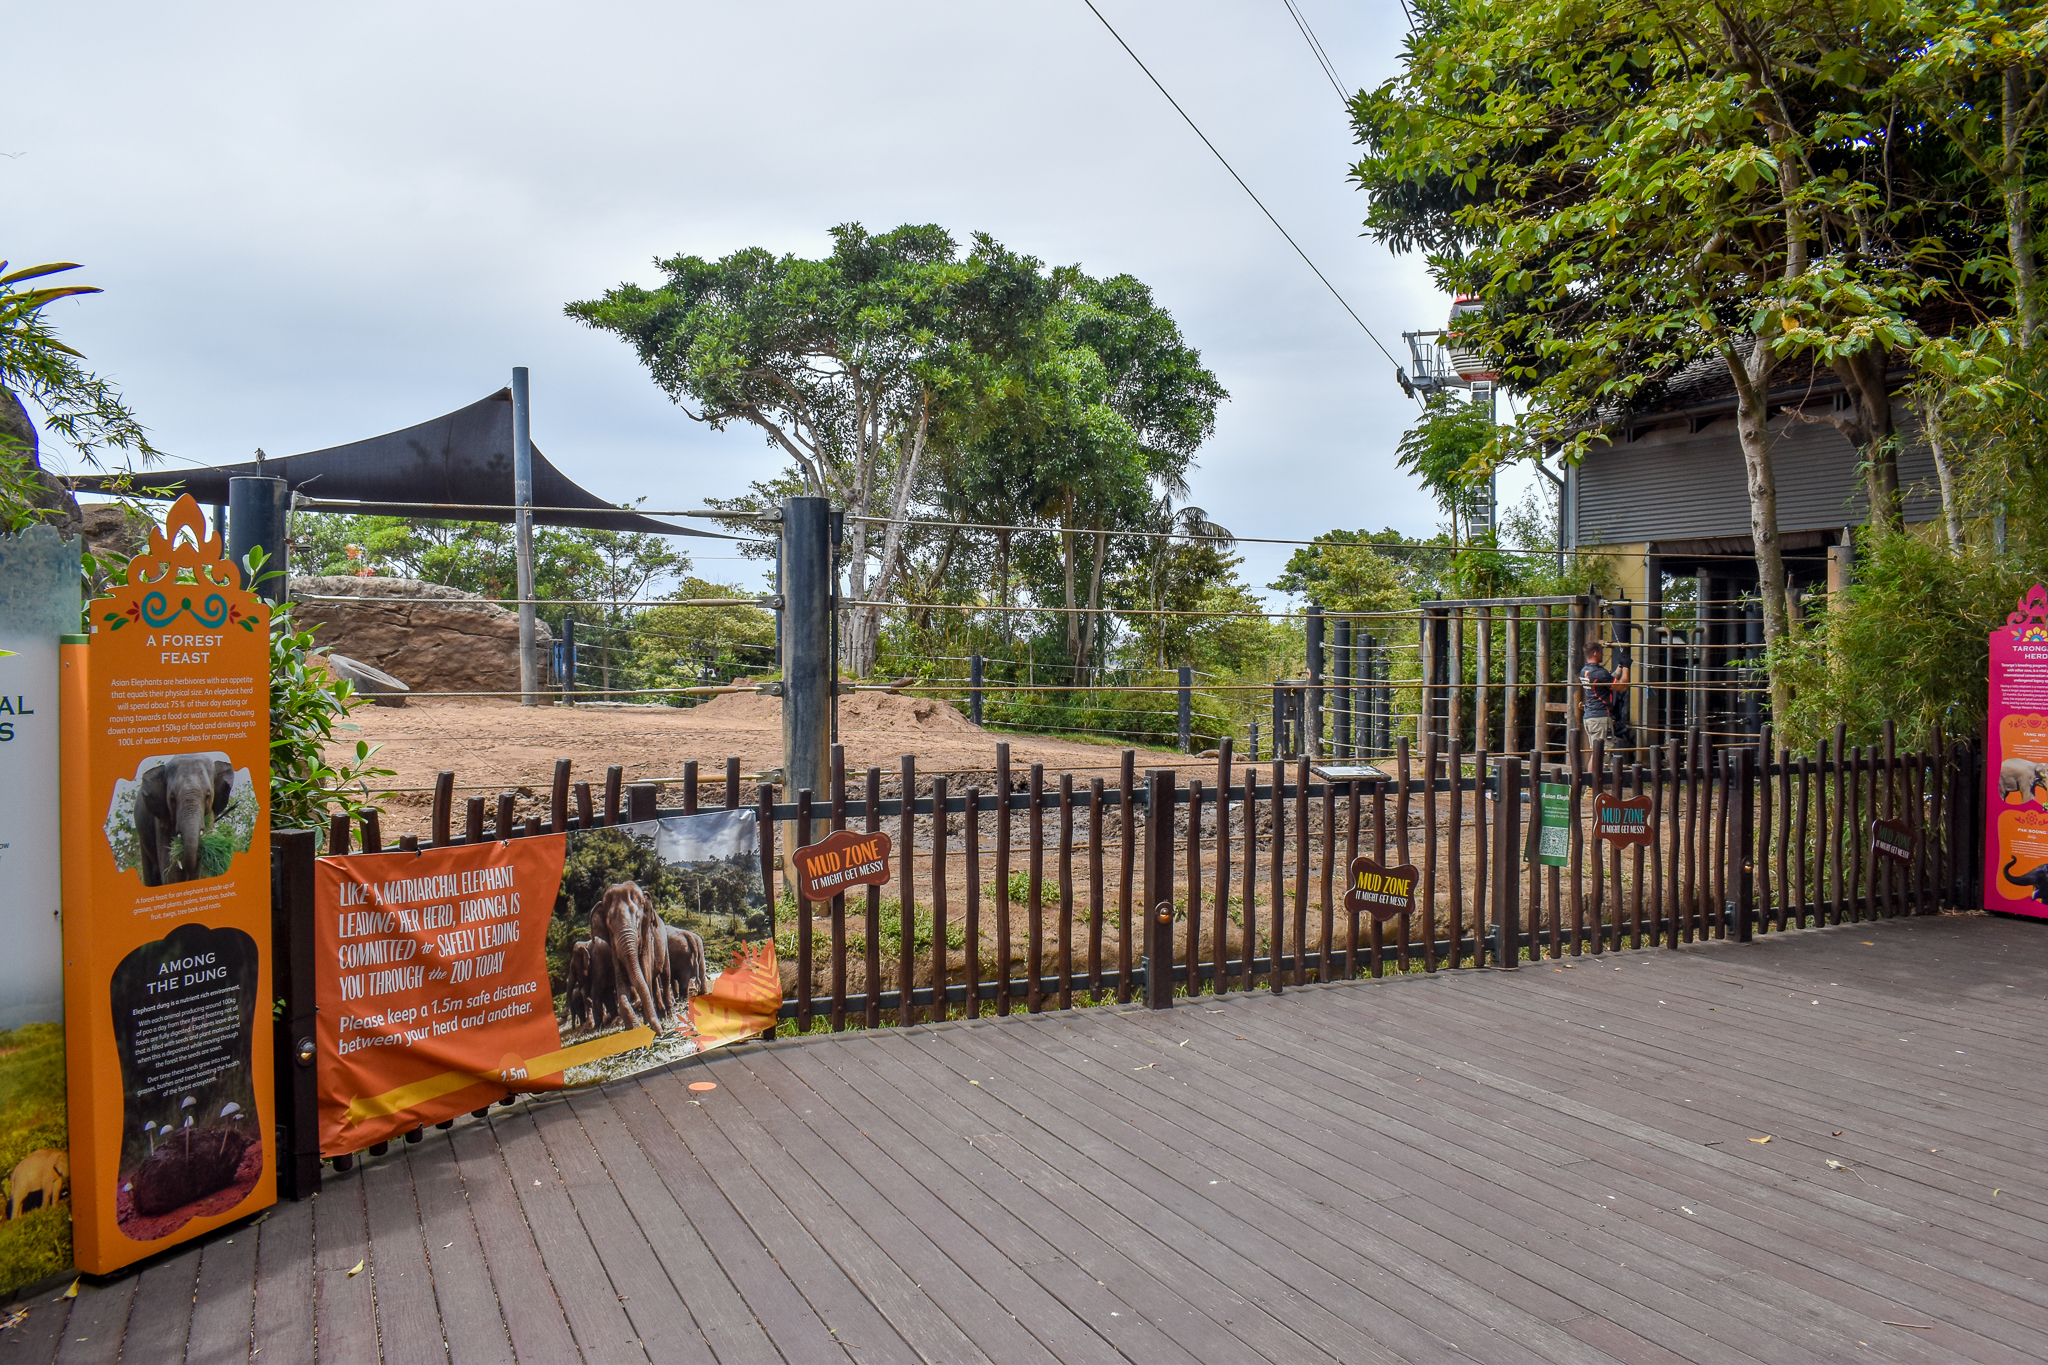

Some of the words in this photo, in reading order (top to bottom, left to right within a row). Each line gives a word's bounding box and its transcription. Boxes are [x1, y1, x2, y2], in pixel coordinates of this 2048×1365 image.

[146, 635, 157, 646] A
[162, 635, 223, 646] FOREST
[161, 652, 210, 663] FEAST
[131, 678, 162, 687] Elephants
[229, 676, 253, 685] appetite
[127, 690, 148, 699] equals
[165, 689, 189, 698] physical
[214, 687, 239, 696] elephant
[109, 715, 134, 723] moving
[136, 713, 160, 721] towards
[230, 709, 255, 718] Chowing
[117, 702, 128, 710] will
[130, 702, 149, 711] spend
[210, 699, 221, 708] day
[222, 699, 240, 707] eating
[108, 727, 126, 735] down
[137, 725, 160, 733] around
[162, 724, 180, 733] 150kg
[189, 722, 203, 730] food
[217, 721, 240, 729] drinking
[118, 738, 134, 746] 100L
[136, 736, 143, 745] of
[169, 735, 180, 744] day
[182, 734, 201, 742] makes
[212, 733, 228, 741] many
[1601, 808, 1621, 824] MUD
[1623, 808, 1645, 824] ZONE
[1601, 825, 1606, 834] IT
[1606, 825, 1620, 834] MIGHT
[1621, 825, 1629, 834] GET
[1630, 826, 1645, 834] MESSY
[806, 851, 840, 878] MUD
[842, 839, 882, 868] ZONE
[339, 882, 369, 907] LIKE
[374, 882, 384, 906] A
[384, 874, 460, 904] MATRIARCHAL
[462, 865, 514, 895] ELEPHANT
[812, 879, 819, 890] IT
[820, 872, 843, 888] MIGHT
[845, 867, 858, 881] GET
[859, 860, 884, 877] MESSY
[1357, 872, 1382, 892] MUD
[1383, 876, 1411, 897] ZONE
[1355, 890, 1361, 899] IT
[1361, 891, 1379, 903] MIGHT
[1379, 894, 1389, 904] GET
[1389, 896, 1408, 908] MESSY
[339, 911, 396, 938] LEADING
[398, 908, 421, 933] HER
[423, 904, 456, 928] HERD,
[459, 894, 508, 924] TARONGA
[510, 892, 520, 915] IS
[338, 939, 417, 969] COMMITTED
[421, 942, 434, 954] to
[437, 929, 476, 957] SAFELY
[478, 920, 520, 950] LEADING
[158, 952, 216, 975] AMONG
[147, 977, 179, 994] THE
[184, 966, 227, 986] DUNG
[339, 974, 365, 1001] YOU
[369, 966, 425, 997] THROUGH
[428, 966, 447, 980] the
[450, 959, 473, 984] ZOO
[476, 951, 506, 978] TODAY
[132, 1005, 156, 1016] Elephant
[156, 1002, 170, 1010] dung
[180, 994, 199, 1003] nutrient
[138, 1019, 150, 1027] With
[152, 1016, 163, 1024] each
[164, 1010, 180, 1020] animal
[181, 1006, 204, 1016] producing
[205, 1001, 221, 1010] around
[340, 1014, 385, 1032] Please
[387, 1006, 417, 1025] keep
[421, 1006, 428, 1017] a
[431, 998, 462, 1014] 1.5m
[466, 992, 490, 1009] safe
[493, 980, 537, 1002] distance
[339, 1033, 402, 1055] between
[404, 1026, 430, 1047] your
[433, 1016, 458, 1036] herd
[461, 1011, 484, 1029] and
[488, 1002, 533, 1022] another.
[501, 1067, 527, 1082] 1.5m
